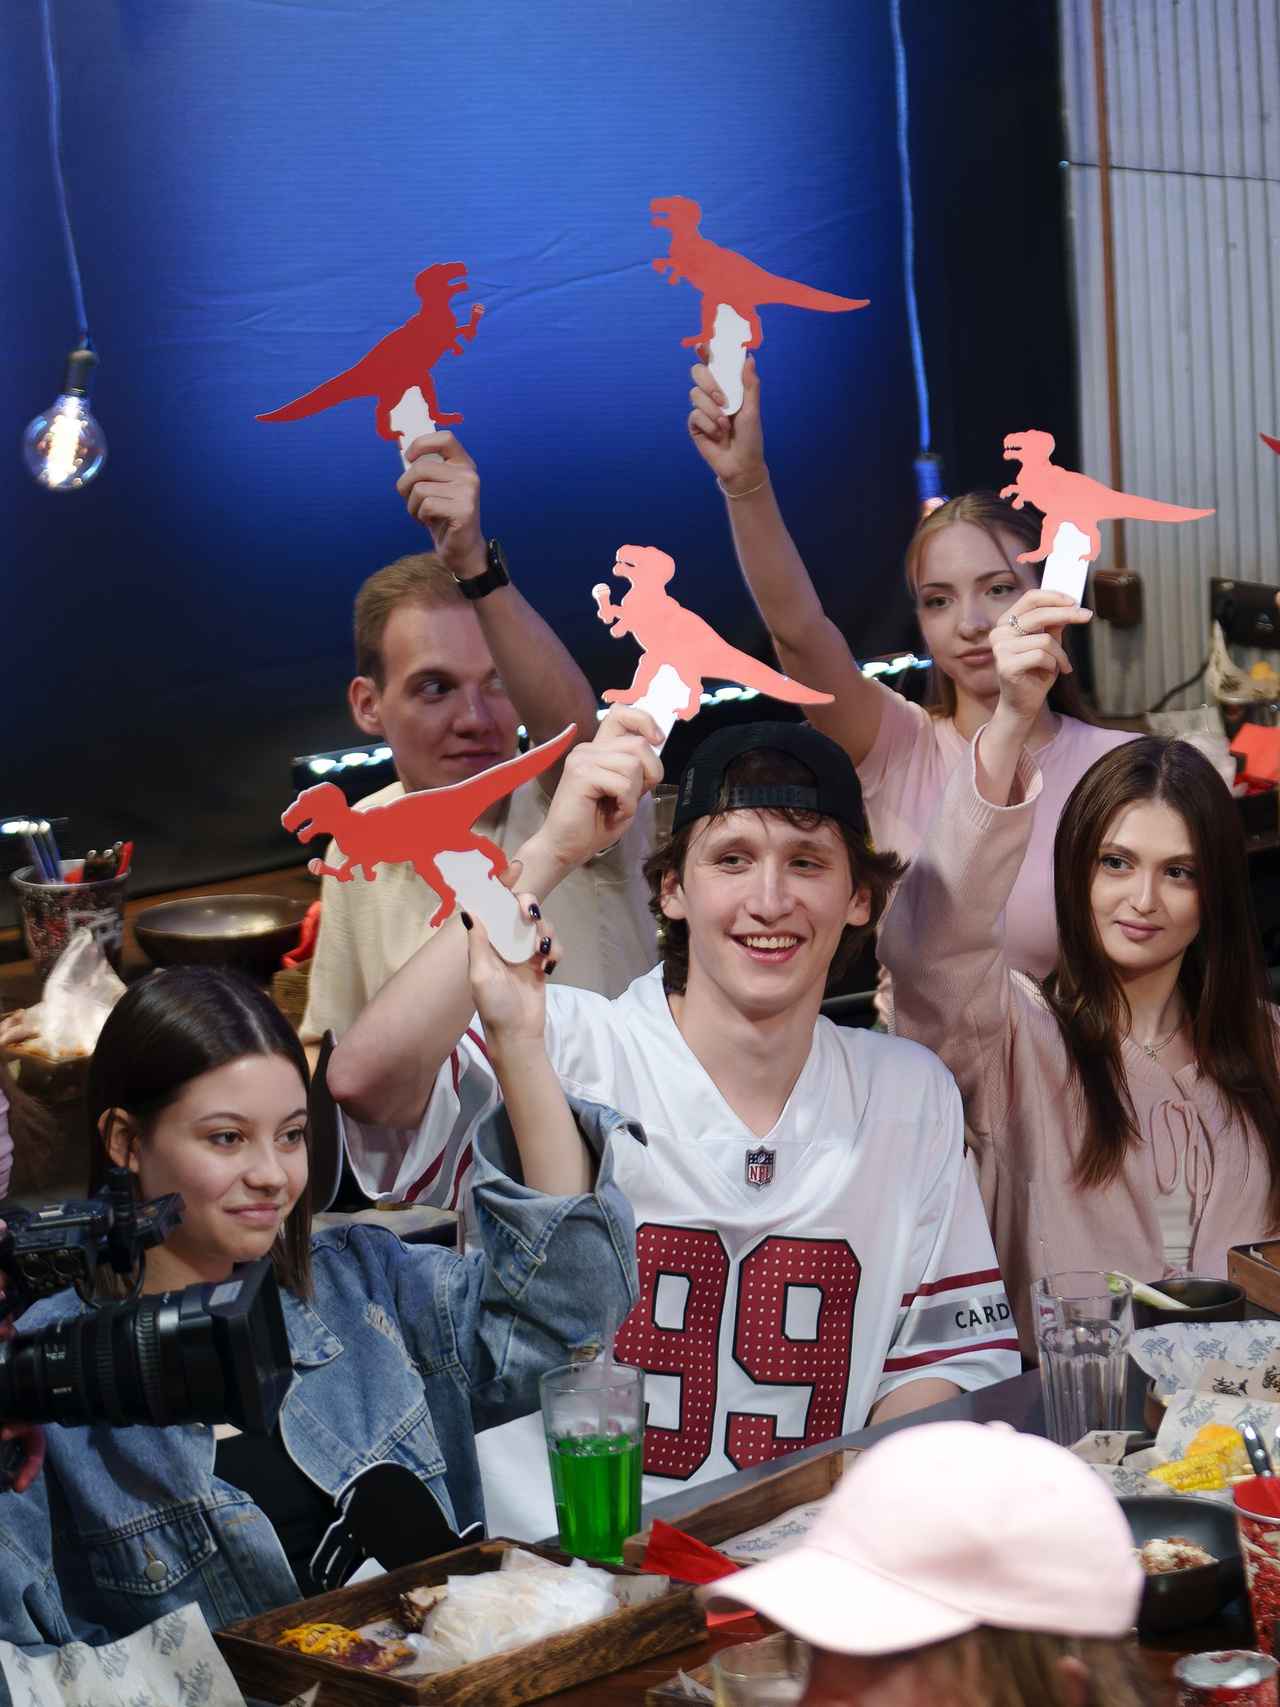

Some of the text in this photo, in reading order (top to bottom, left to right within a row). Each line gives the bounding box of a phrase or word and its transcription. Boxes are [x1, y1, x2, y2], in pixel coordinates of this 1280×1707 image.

[749, 1165, 772, 1183] NFL
[955, 1302, 1011, 1329] CARD
[613, 1221, 863, 1481] 99
